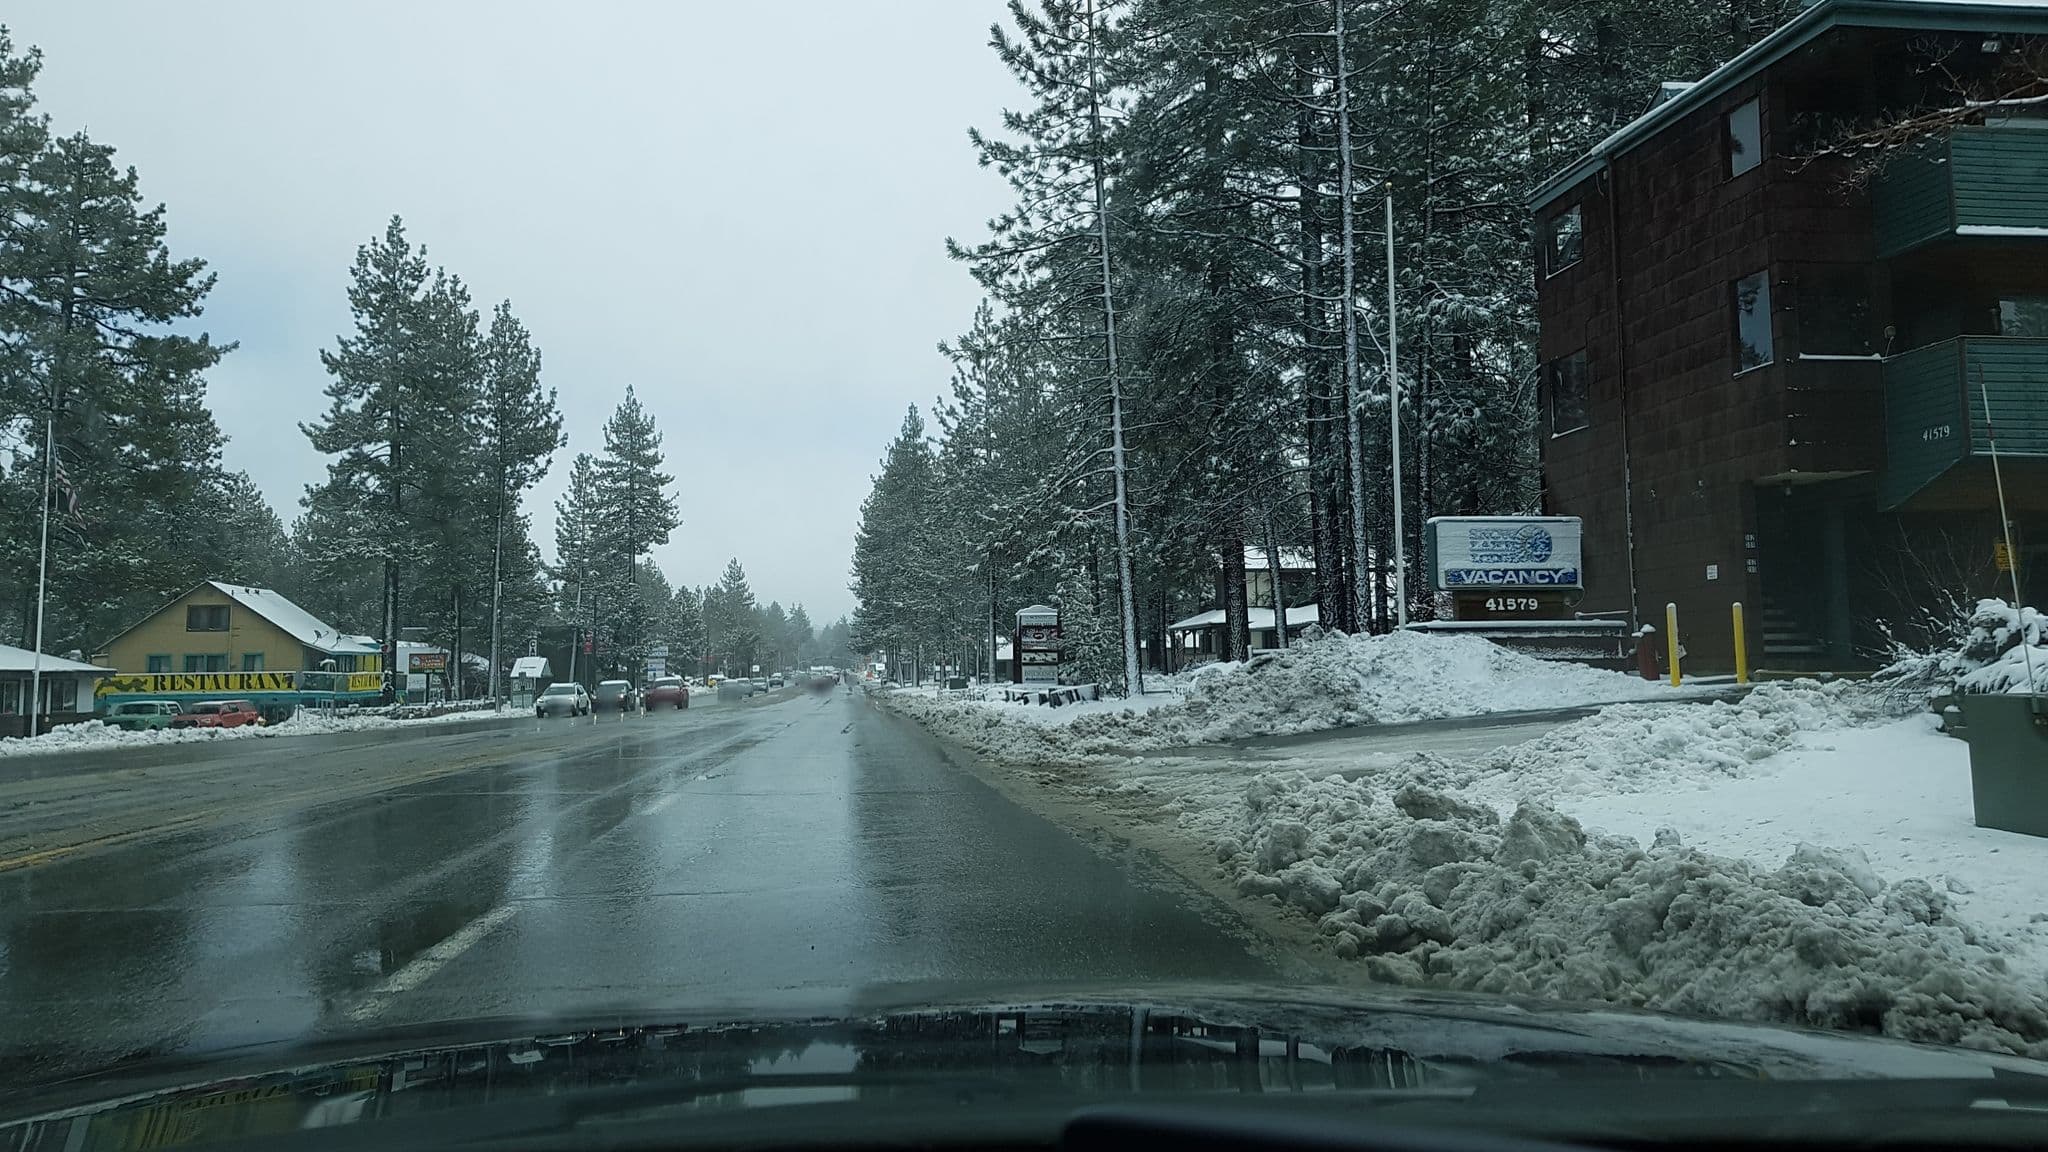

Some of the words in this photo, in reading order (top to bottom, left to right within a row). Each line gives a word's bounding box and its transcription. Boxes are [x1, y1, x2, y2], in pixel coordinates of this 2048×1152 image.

[1922, 425, 1950, 441] 41579
[1460, 569, 1563, 585] VACANCY
[1485, 597, 1539, 611] 41579
[153, 673, 294, 691] RESTAURANT
